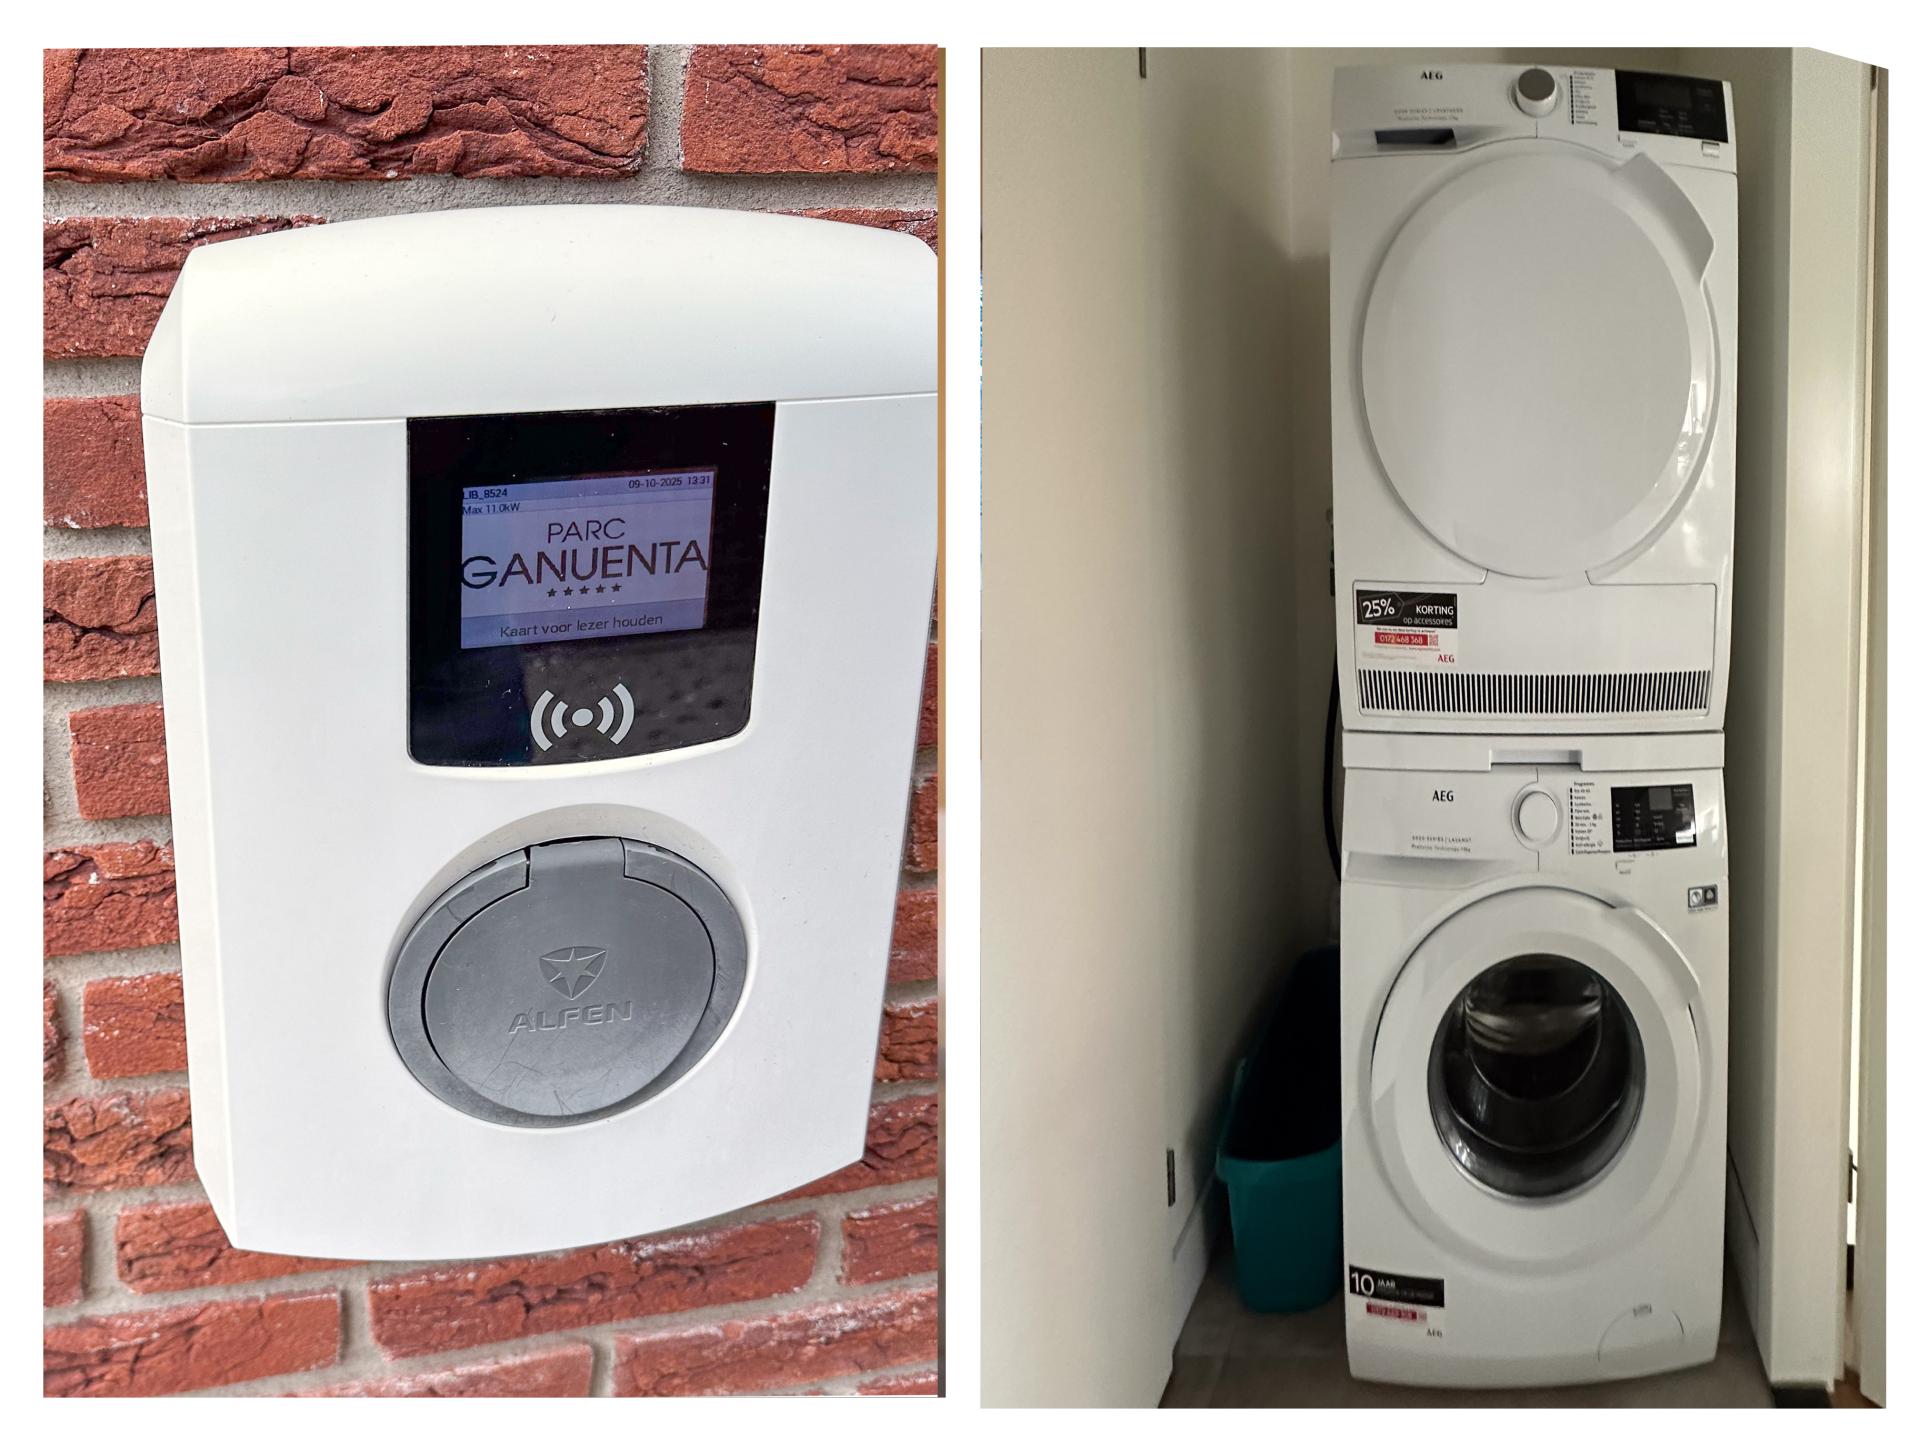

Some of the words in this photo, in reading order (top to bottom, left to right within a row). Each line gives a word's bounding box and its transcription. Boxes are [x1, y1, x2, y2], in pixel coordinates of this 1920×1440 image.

[1420, 70, 1443, 80] AEG
[628, 476, 682, 489] 09-10-2025
[547, 517, 626, 544] PARC
[461, 539, 709, 589] GANUENTA
[1362, 598, 1395, 619] 25%
[1416, 605, 1454, 615] KORTING
[500, 624, 539, 639] Kaart
[542, 622, 571, 635] voor
[577, 617, 608, 632] lezer
[612, 614, 663, 630] houden
[1403, 616, 1413, 625] op
[1414, 618, 1453, 626] accessoires
[1437, 654, 1455, 663] AEG
[1432, 790, 1454, 802] AEG
[508, 1000, 633, 1034] ALFEN
[1351, 1272, 1375, 1297] 10
